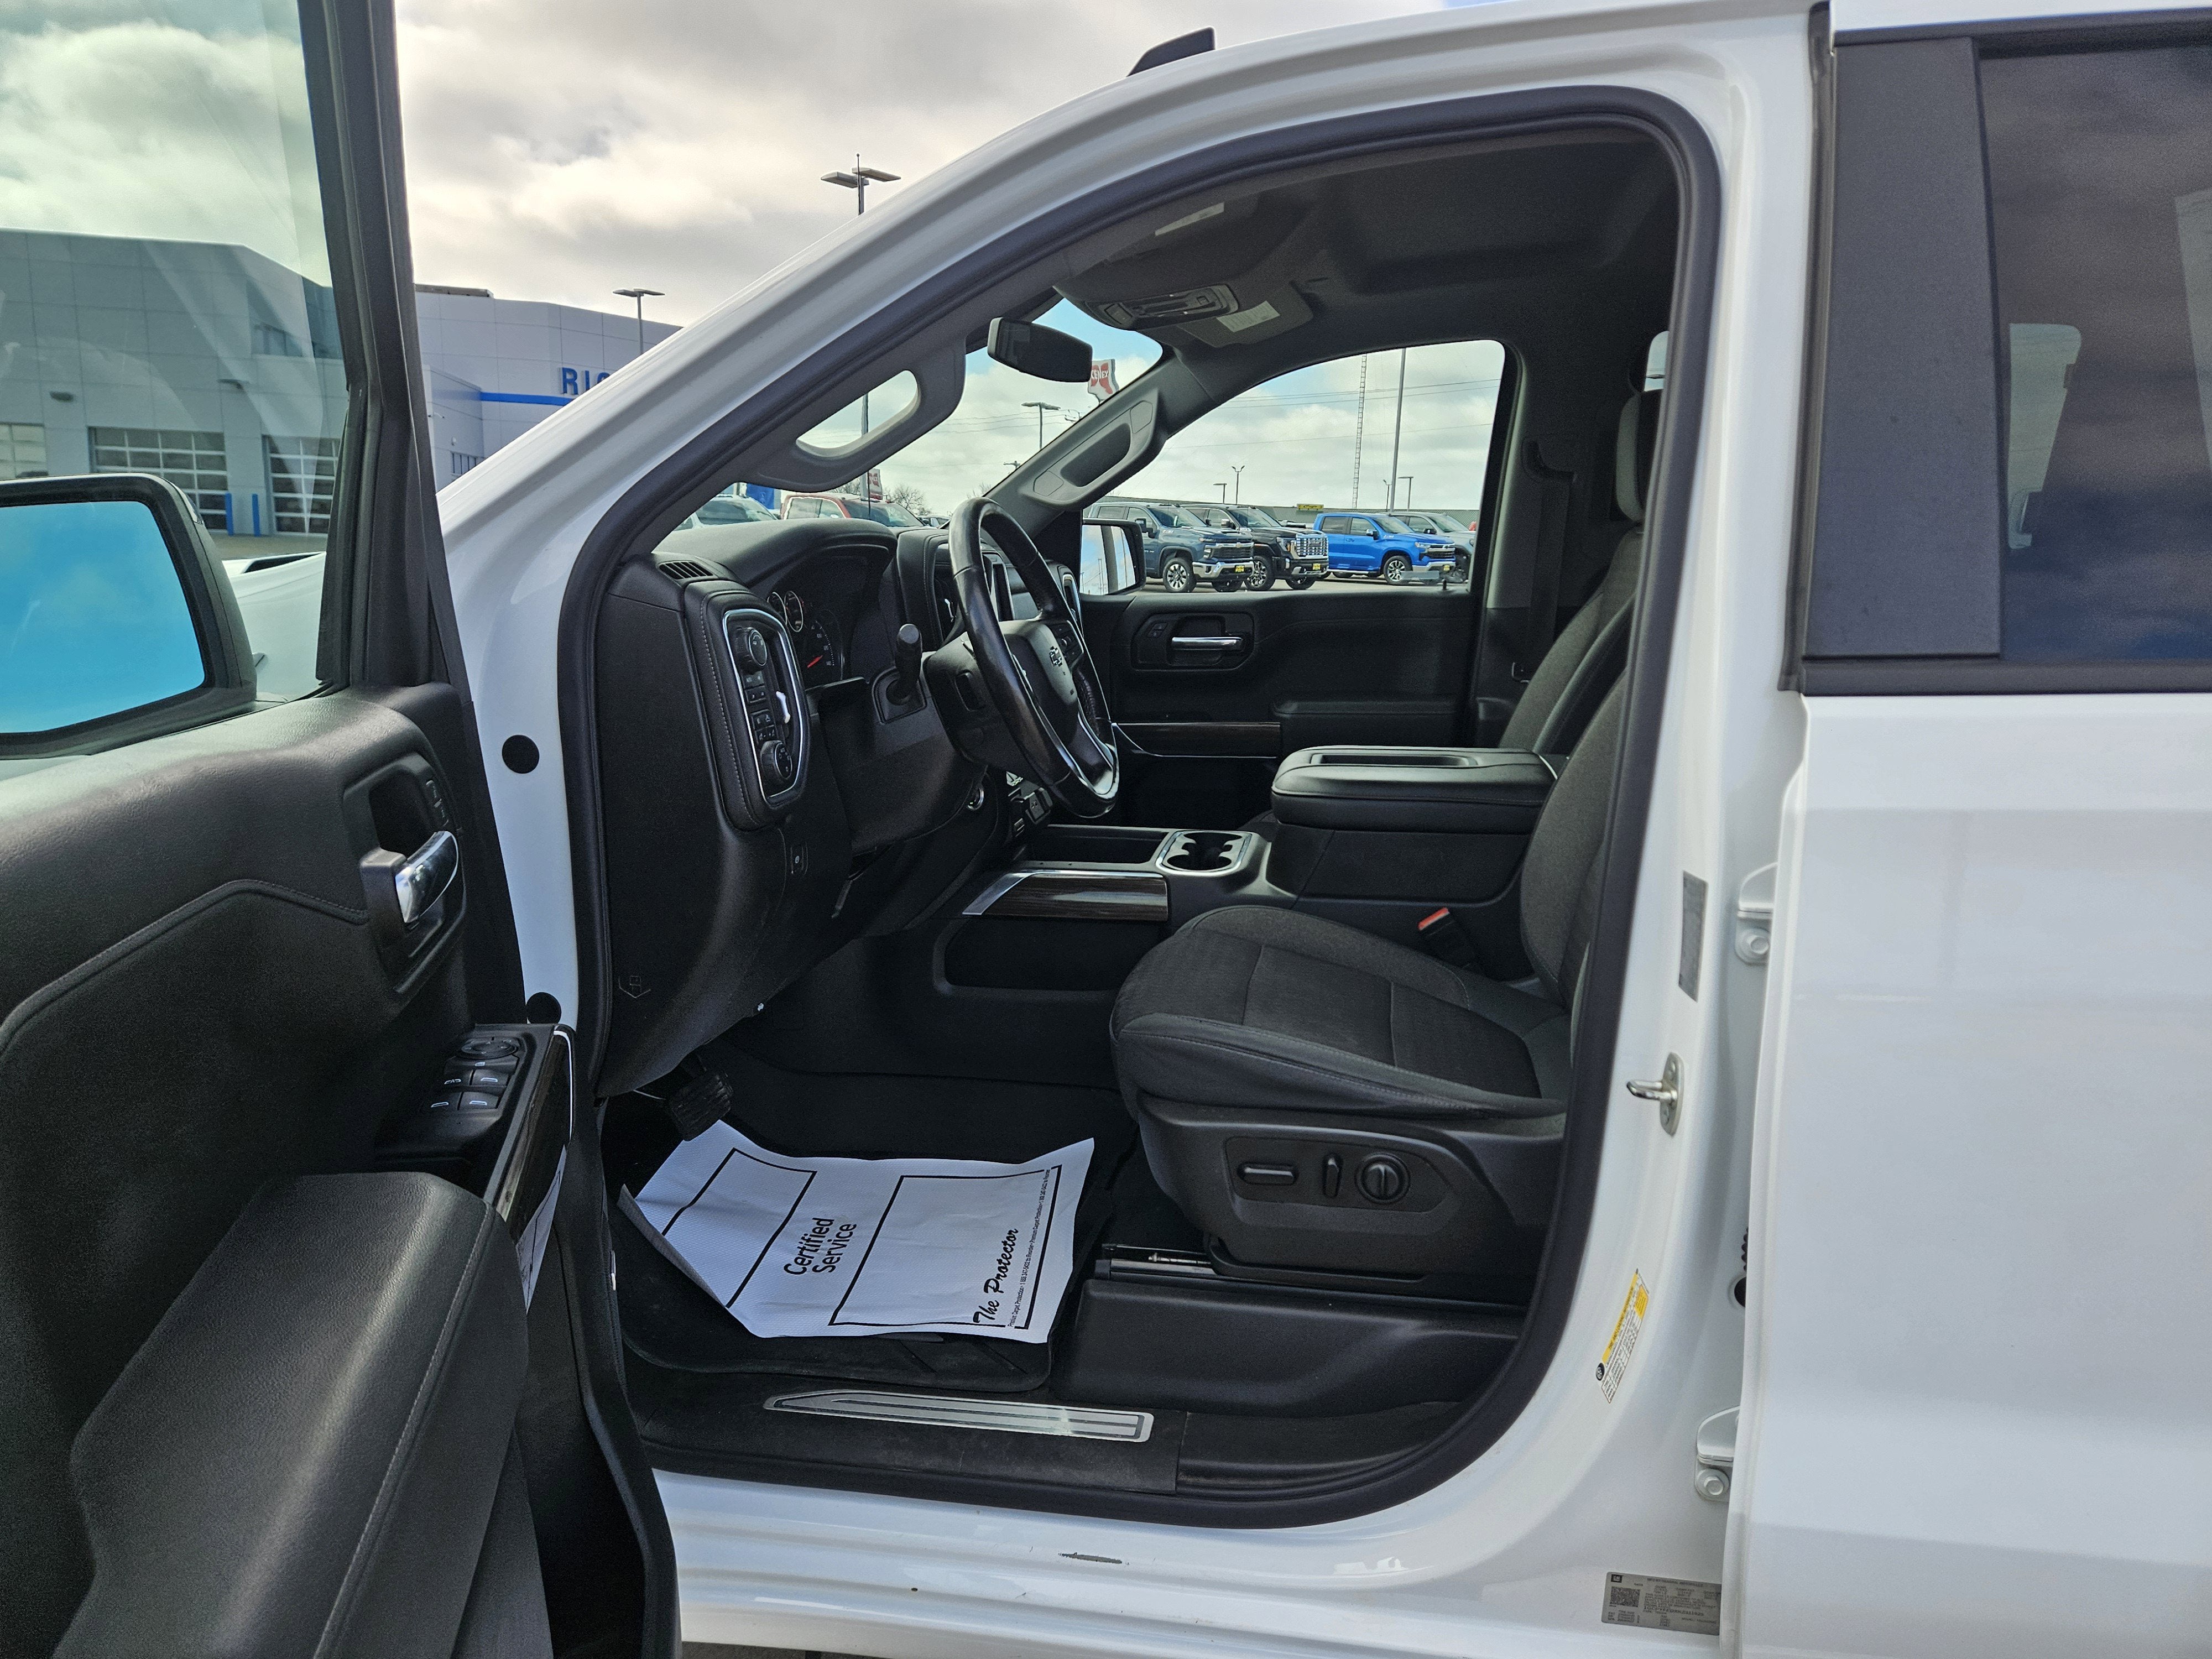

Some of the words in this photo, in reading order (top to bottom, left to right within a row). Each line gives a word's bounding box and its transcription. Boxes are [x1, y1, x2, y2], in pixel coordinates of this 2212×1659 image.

[784, 1217, 834, 1275] Certified
[812, 1224, 857, 1273] Service
[983, 1228, 1019, 1293] Protector
[972, 1300, 1000, 1323] The
